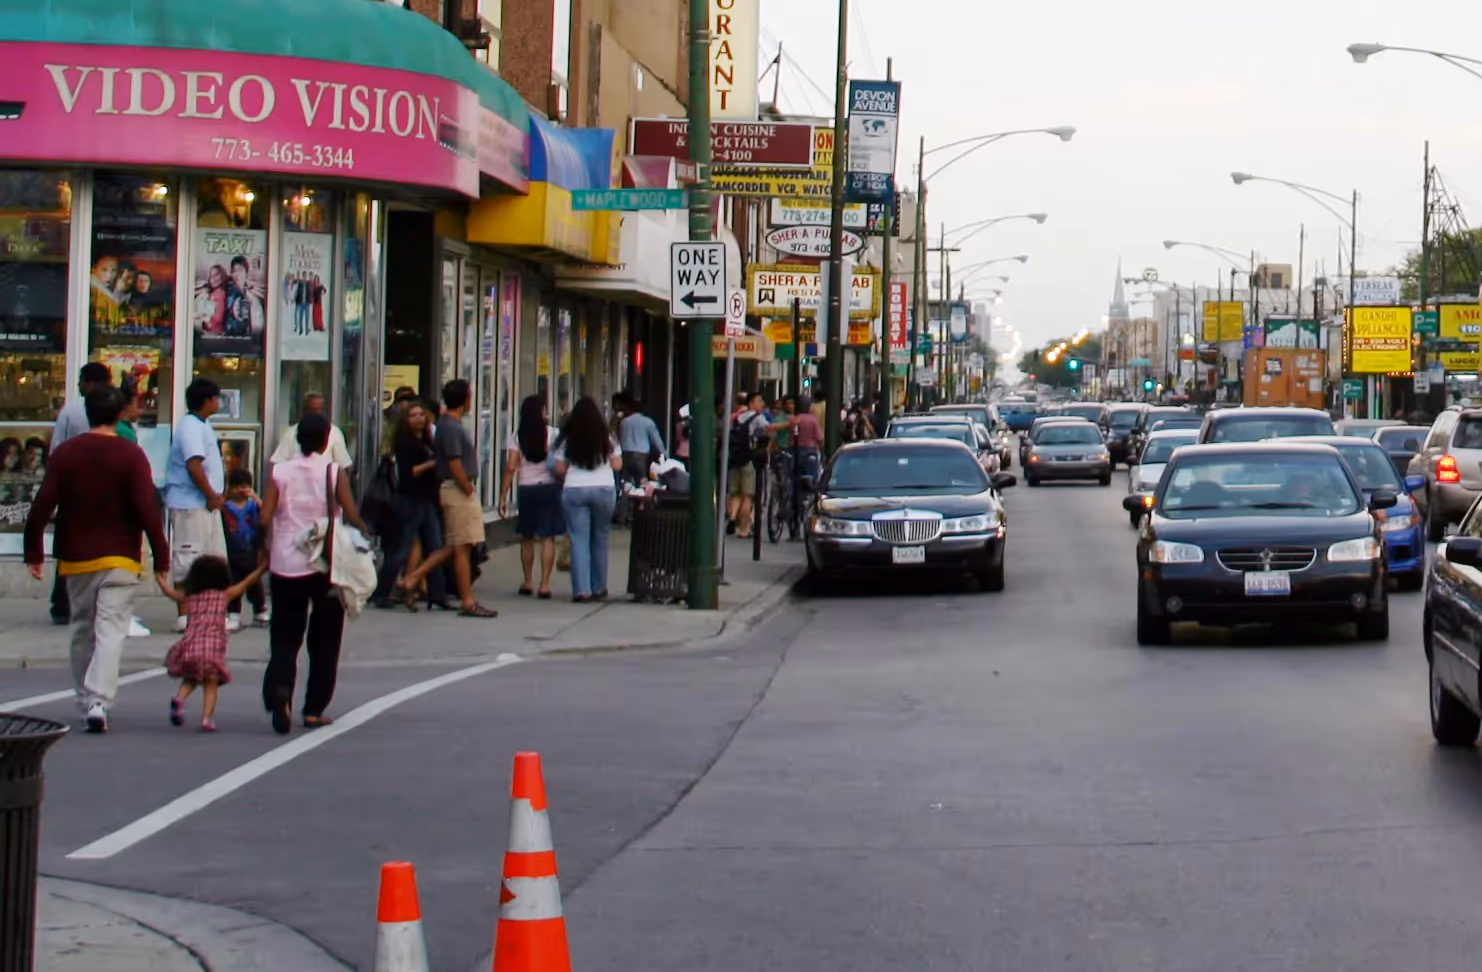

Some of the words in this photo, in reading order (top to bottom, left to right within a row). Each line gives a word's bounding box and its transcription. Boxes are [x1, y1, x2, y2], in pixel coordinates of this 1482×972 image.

[44, 63, 276, 123] VIDEO
[290, 78, 442, 143] VISION
[854, 89, 896, 103] DEVON
[853, 100, 896, 112] AVENUE
[668, 122, 720, 135] INN
[723, 124, 777, 137] CUISINE
[676, 136, 686, 147] &
[710, 136, 769, 149] OCKTAILS
[711, 150, 753, 161] 3-4100
[802, 184, 832, 195] WATC
[584, 192, 667, 208] MAPLEWOOD
[206, 238, 255, 254] TAXI
[677, 248, 720, 266] ONE
[677, 269, 720, 286] WAY
[1361, 310, 1398, 322] GANDHI
